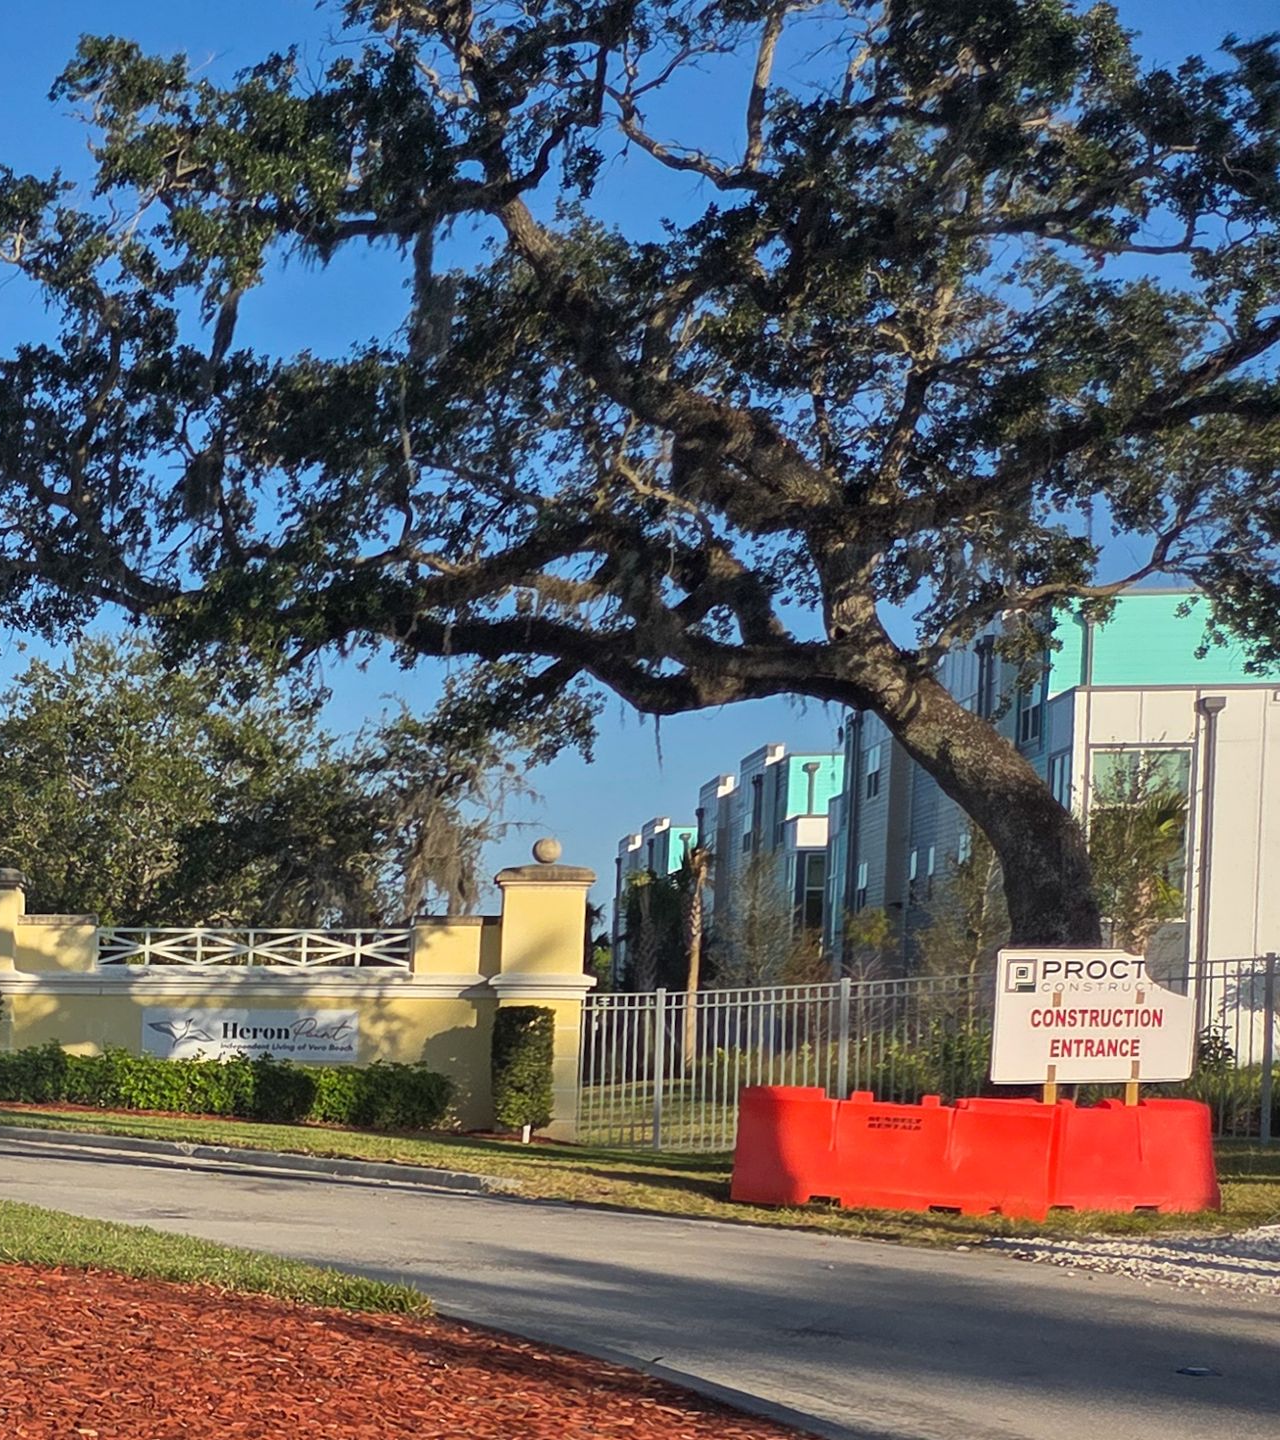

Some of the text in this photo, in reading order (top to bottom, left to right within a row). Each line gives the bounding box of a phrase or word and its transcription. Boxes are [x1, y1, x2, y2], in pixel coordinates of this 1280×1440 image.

[1042, 960, 1146, 980] PROCT
[1031, 1008, 1163, 1027] CONSTRUCTION
[222, 1017, 353, 1042] Heron Point
[1050, 1039, 1140, 1057] ENTRANCE
